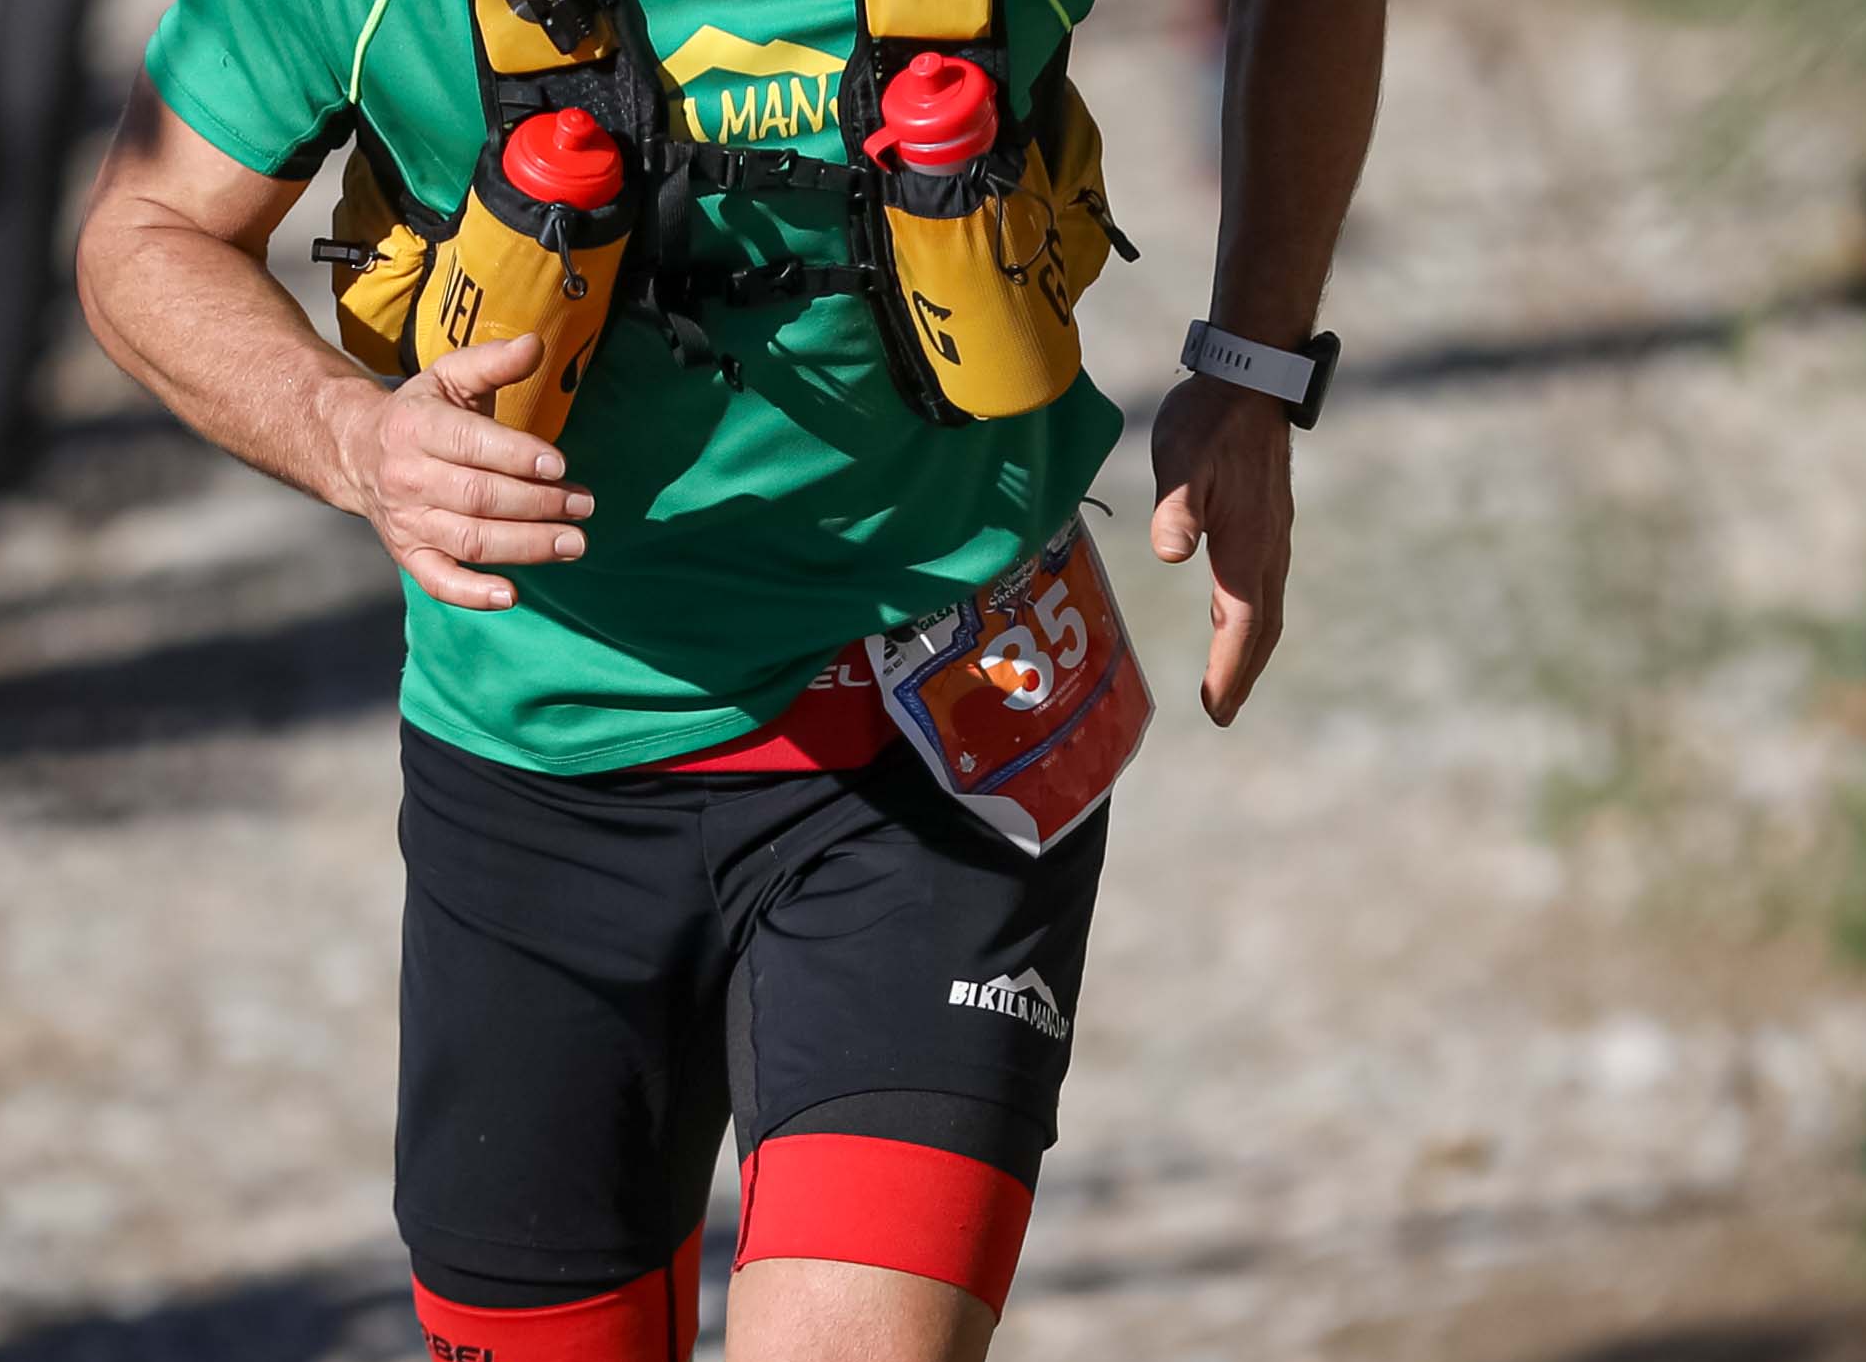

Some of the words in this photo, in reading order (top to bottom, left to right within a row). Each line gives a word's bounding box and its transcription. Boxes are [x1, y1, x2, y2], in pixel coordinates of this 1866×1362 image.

[717, 73, 840, 144] MAN
[977, 578, 1088, 711] 35
[948, 980, 1029, 1022] BIKILA
